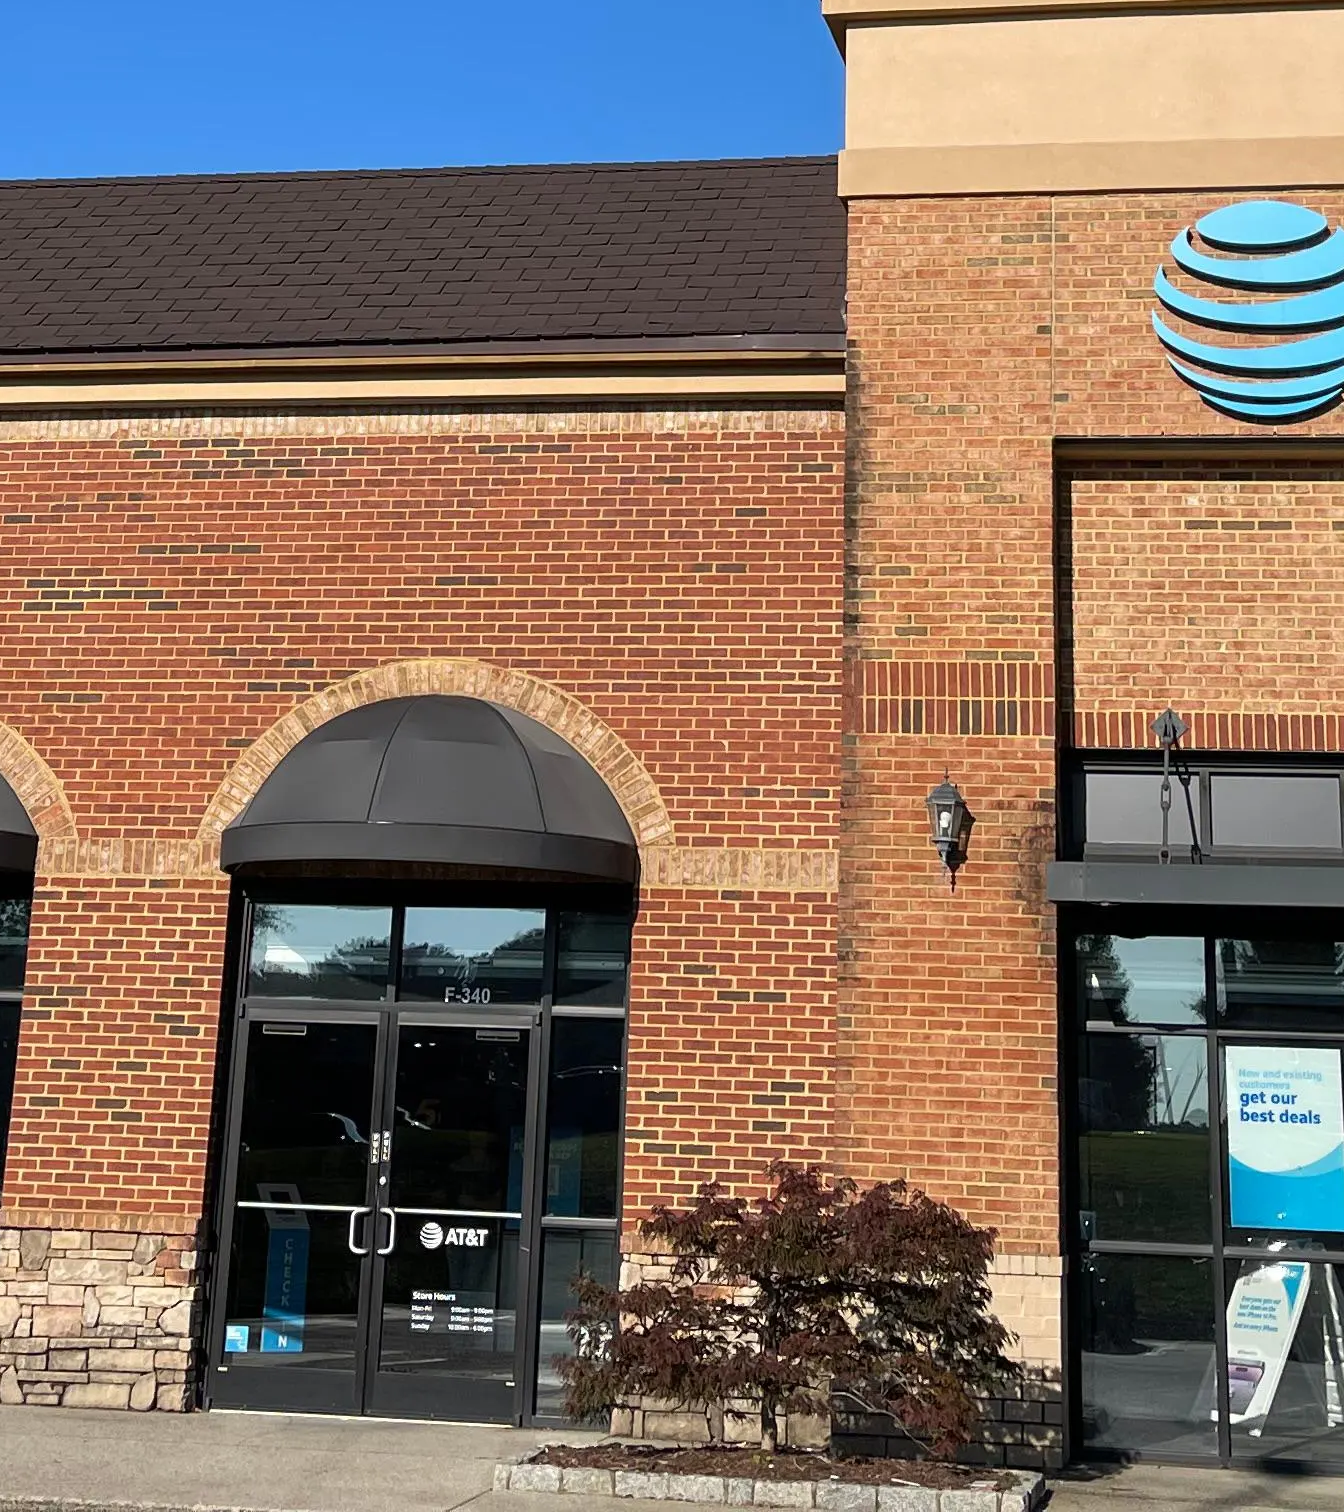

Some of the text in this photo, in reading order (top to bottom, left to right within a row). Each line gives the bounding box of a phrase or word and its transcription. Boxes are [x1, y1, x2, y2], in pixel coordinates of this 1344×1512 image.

[444, 986, 491, 1004] F-340
[1238, 1069, 1323, 1082] New and existing
[1238, 1081, 1291, 1090] customers
[1240, 1091, 1298, 1107] get our
[1240, 1107, 1322, 1125] best deals
[444, 1228, 489, 1247] AT&T
[281, 1238, 295, 1307] CHECK
[412, 1291, 433, 1300] Store
